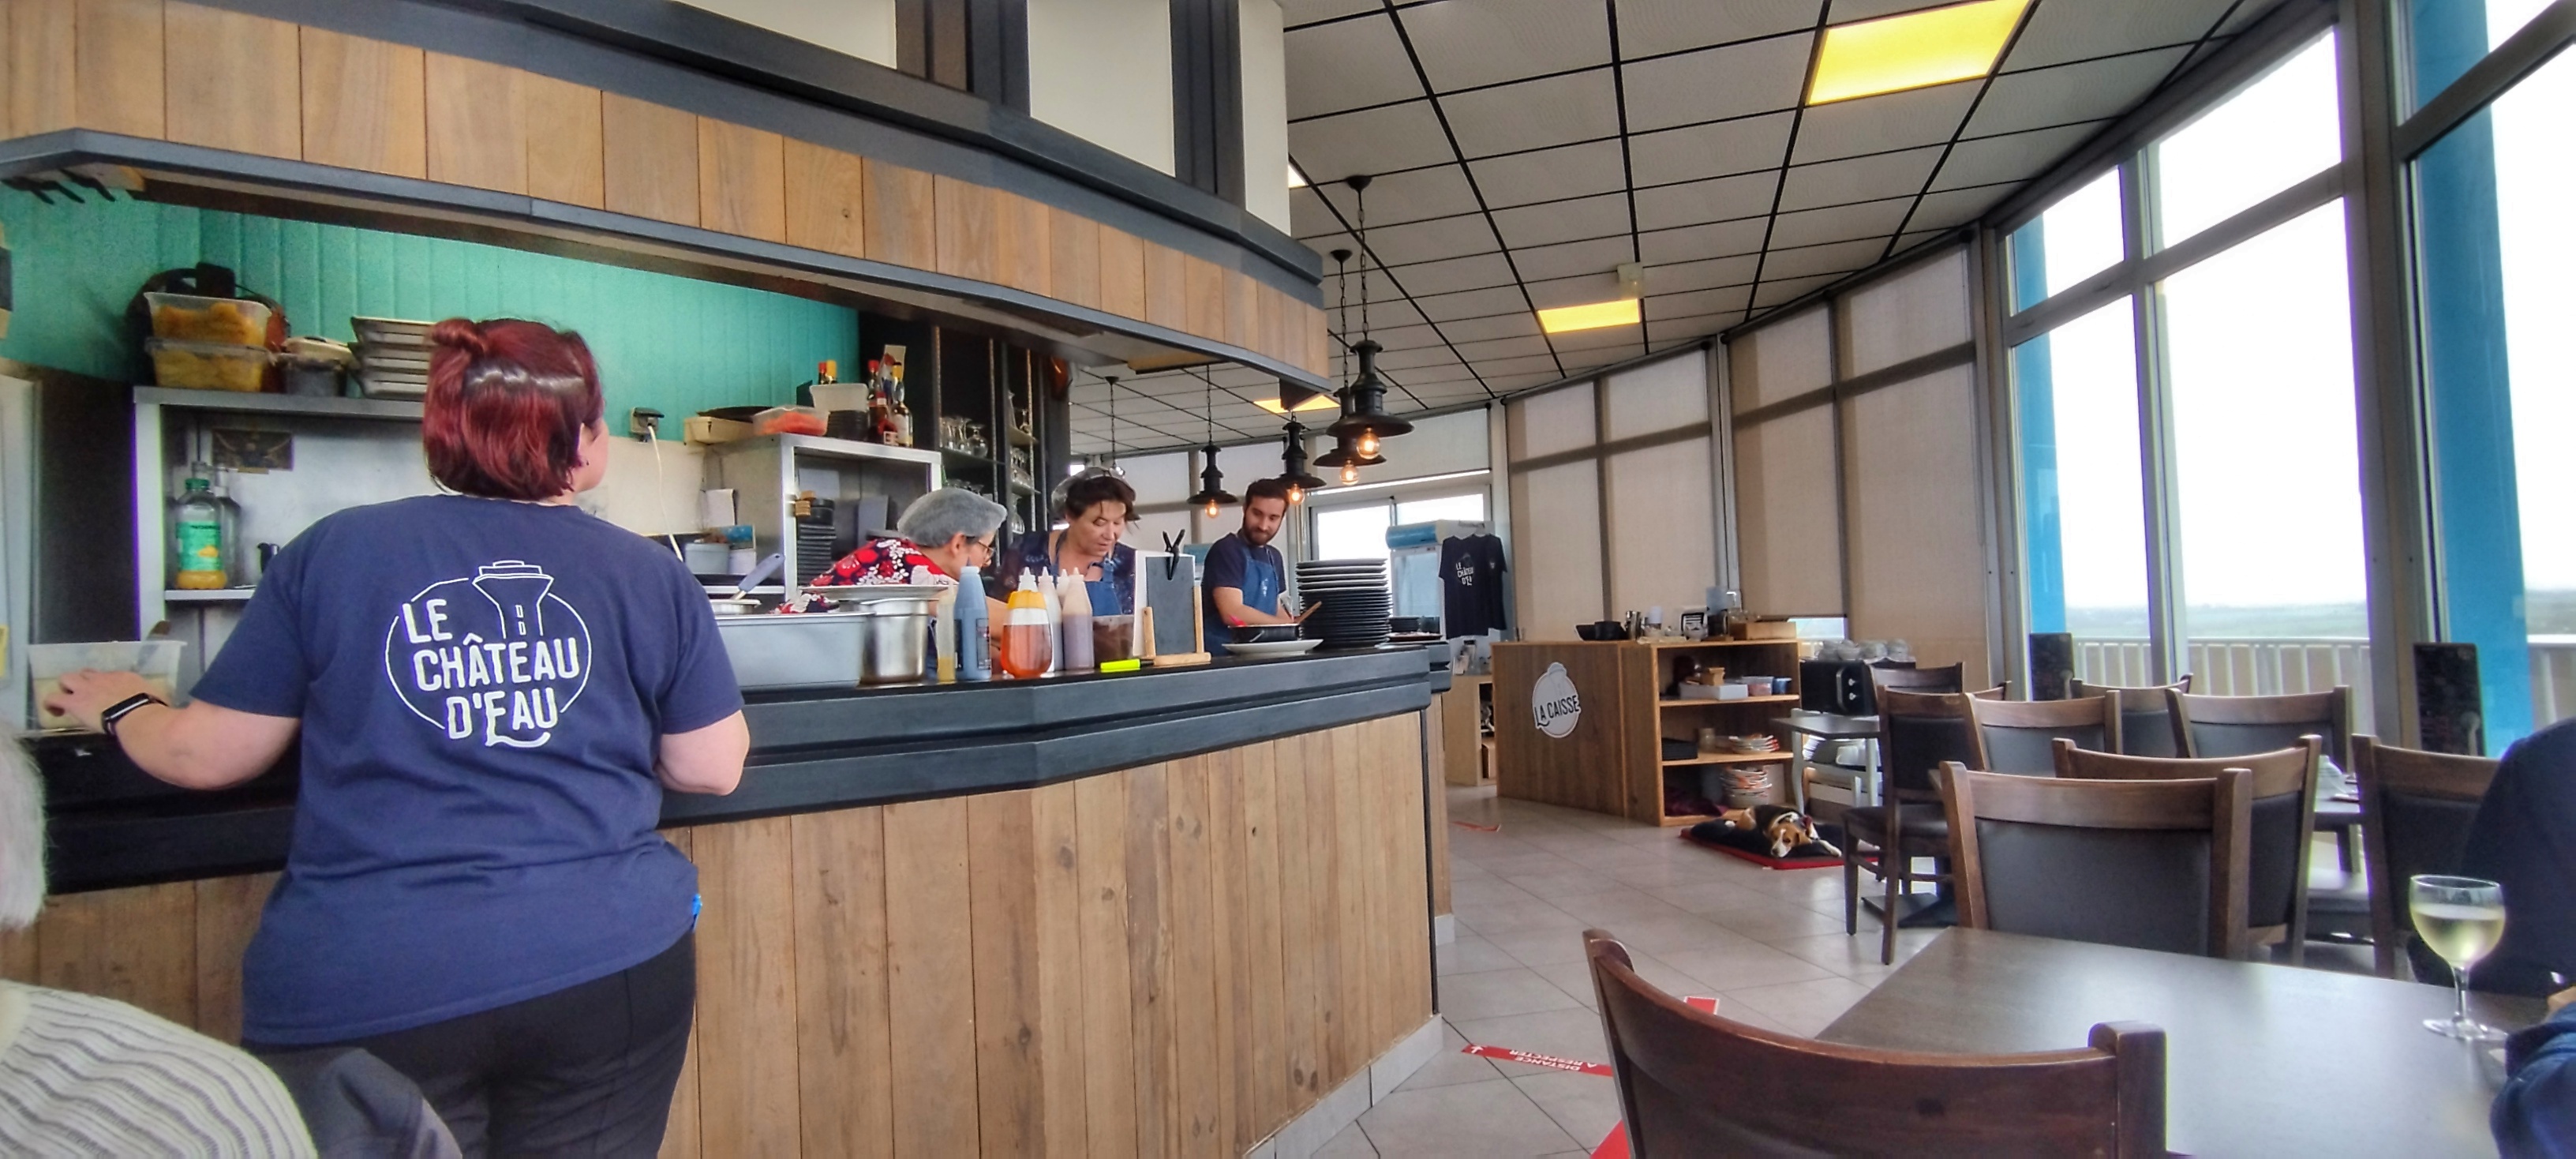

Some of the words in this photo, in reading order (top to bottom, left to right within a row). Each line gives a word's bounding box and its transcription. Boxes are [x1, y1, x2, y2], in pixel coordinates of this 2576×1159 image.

[402, 598, 452, 643] LE
[414, 632, 579, 691] CHÂTEAU
[446, 687, 559, 748] D'EAU
[1534, 705, 1550, 726] LA
[1547, 695, 1580, 719] CAISSE
[1514, 1056, 1581, 1071] DISTANCE
